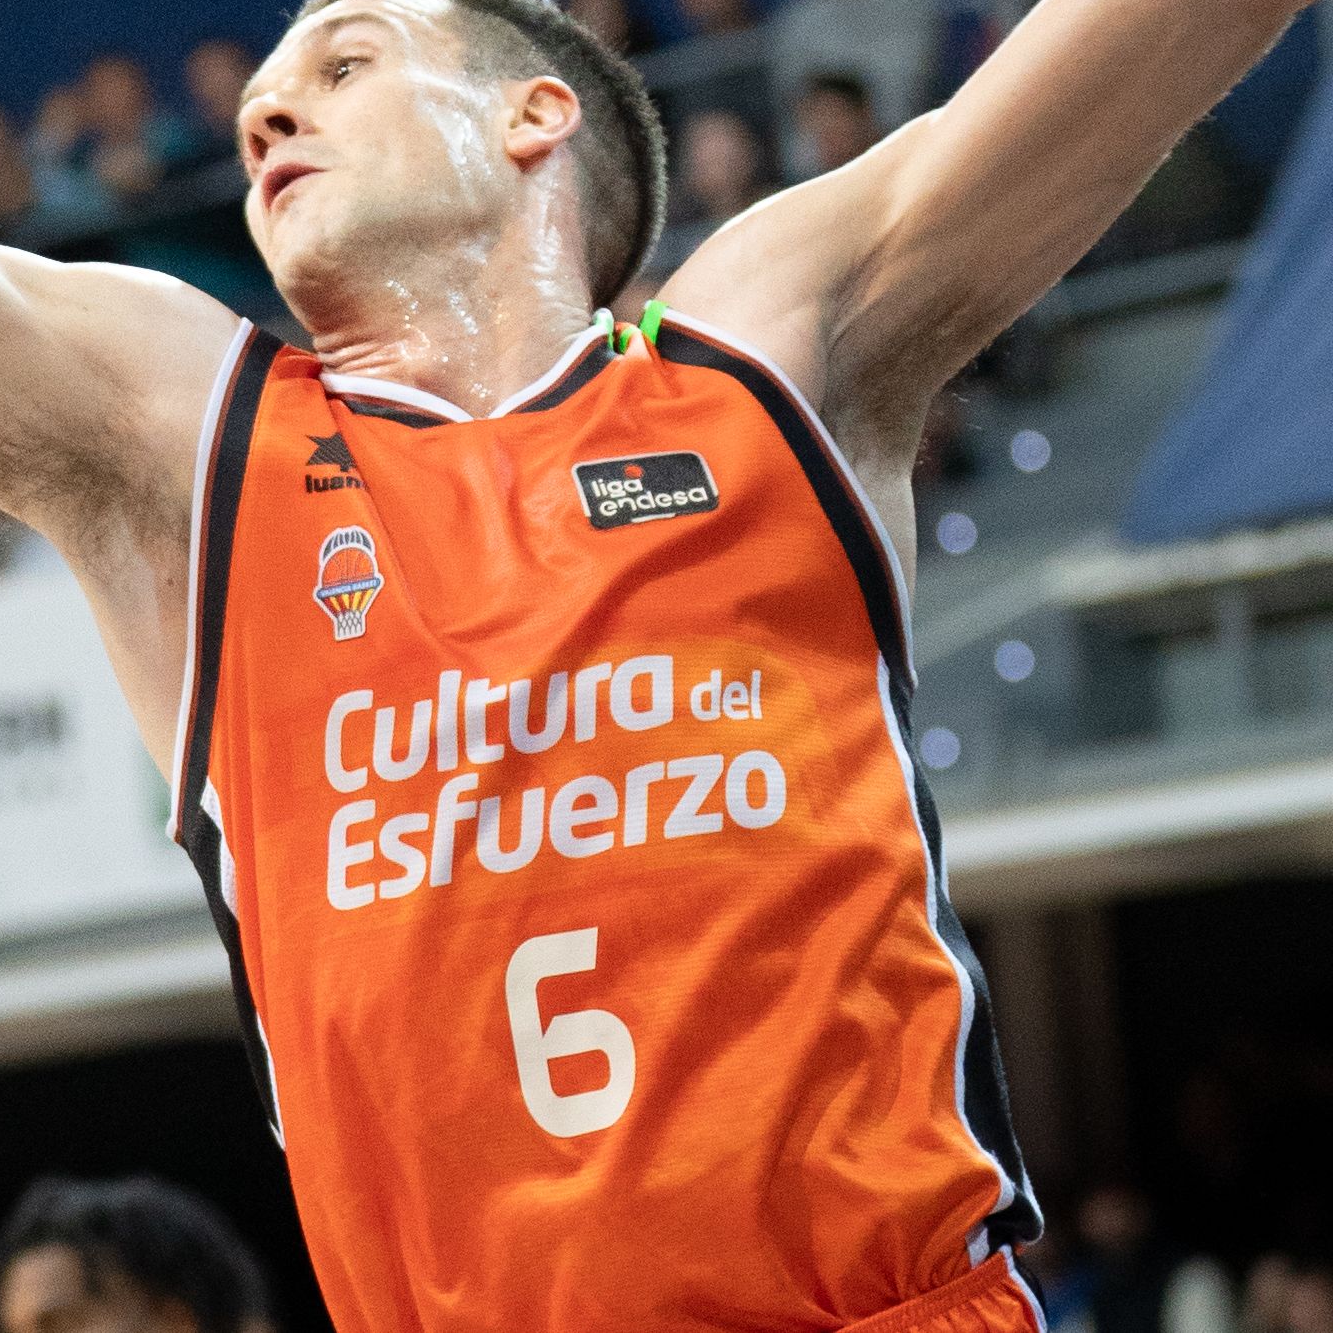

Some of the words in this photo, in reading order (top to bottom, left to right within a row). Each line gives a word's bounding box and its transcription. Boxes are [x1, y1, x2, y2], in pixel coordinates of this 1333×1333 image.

[305, 473, 369, 494] luan
[591, 478, 643, 499] liga
[599, 486, 708, 517] endesa
[325, 655, 675, 794] Cultura
[690, 669, 763, 721] del
[325, 750, 787, 910] Esfuerzo
[505, 927, 637, 1139] 6
